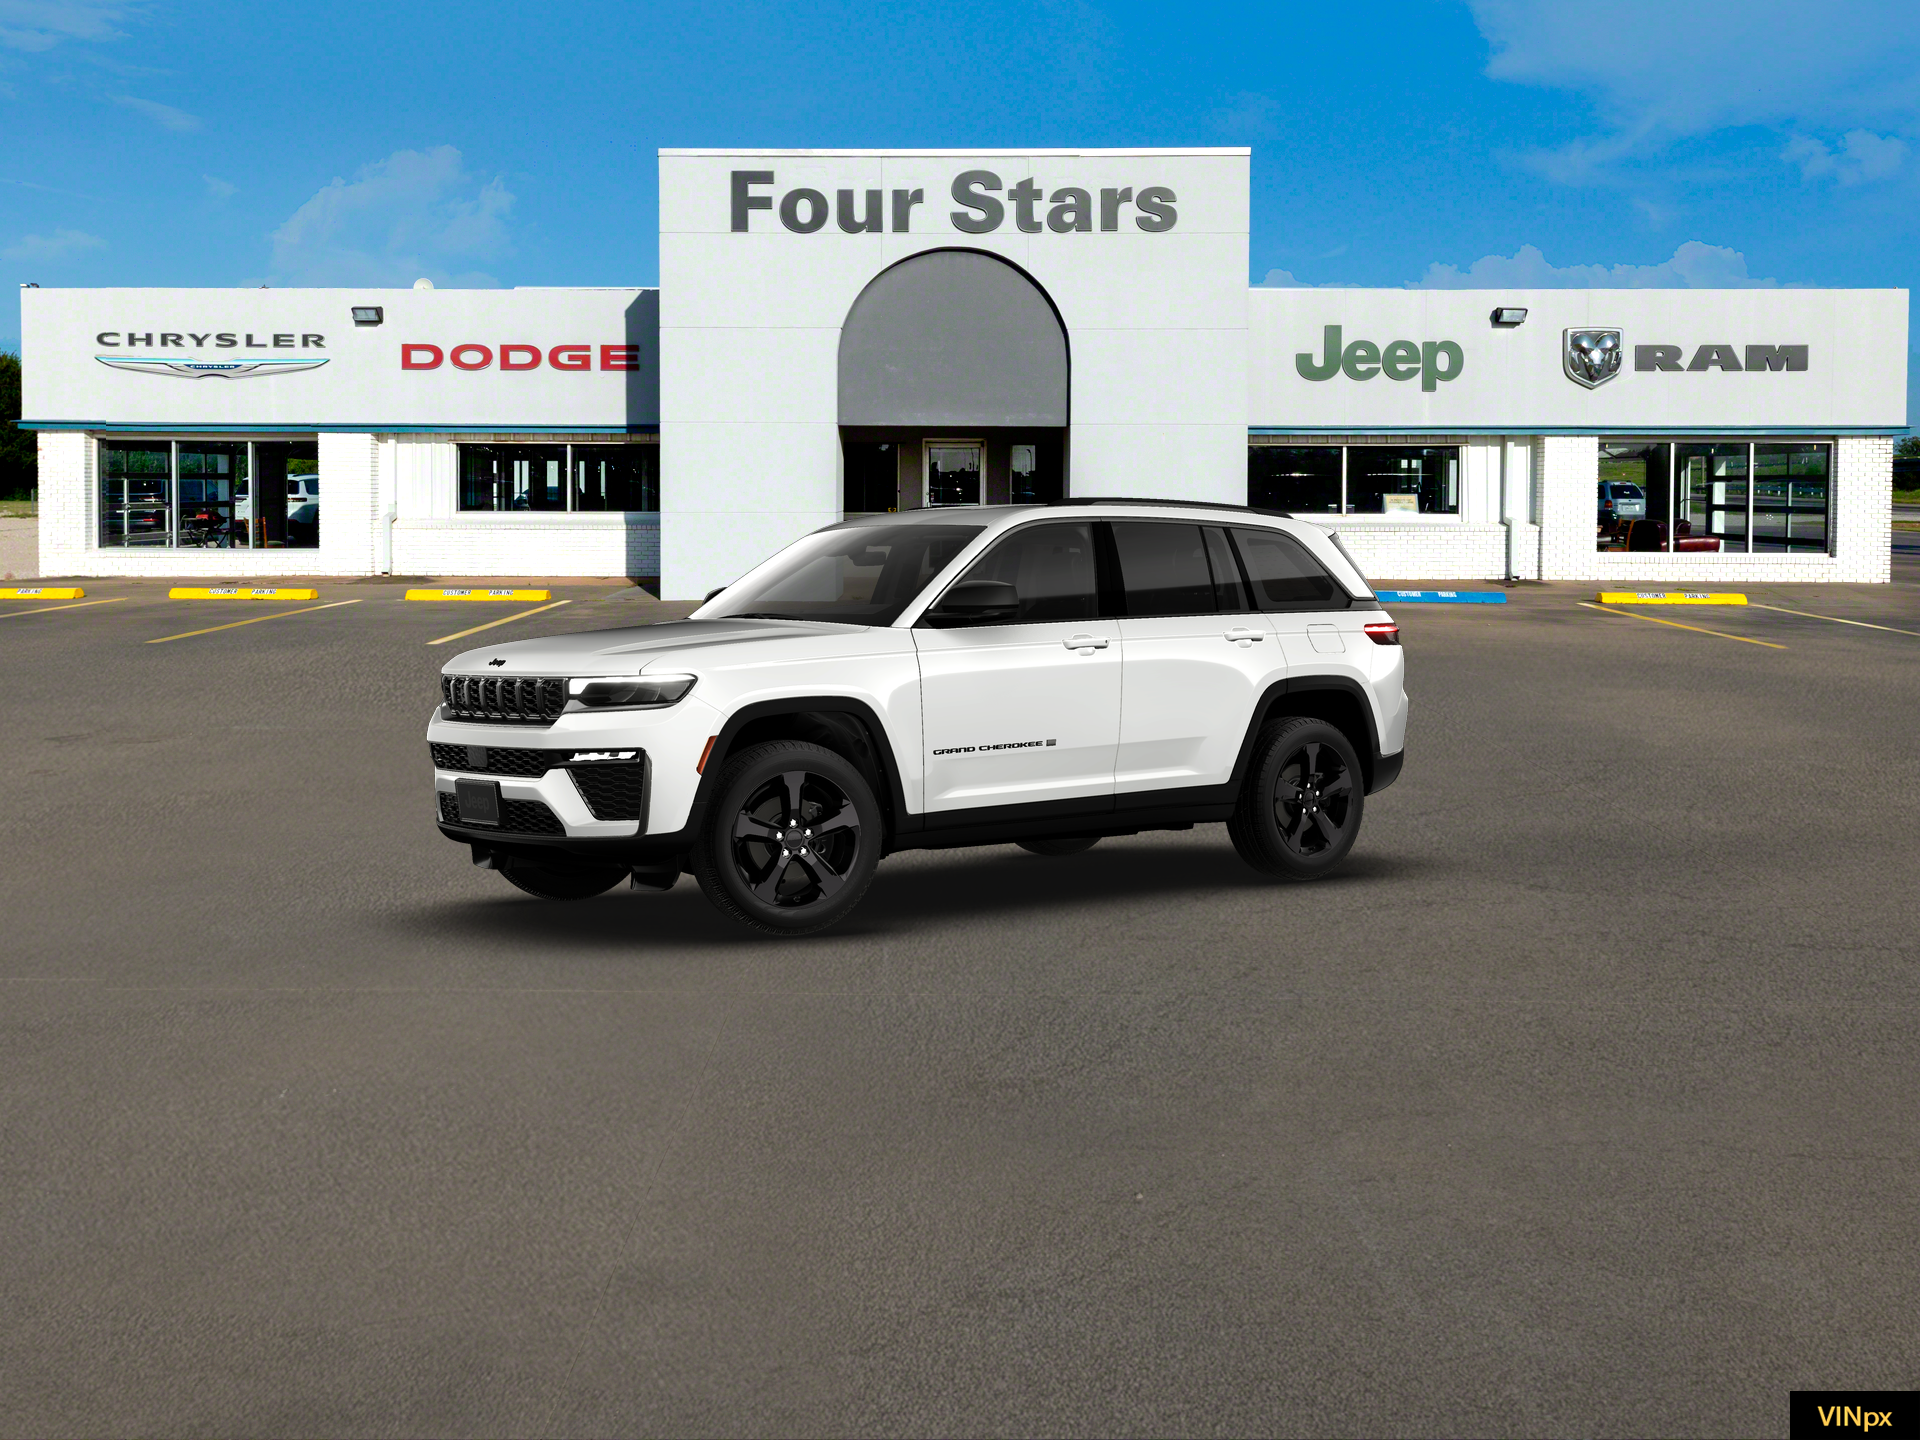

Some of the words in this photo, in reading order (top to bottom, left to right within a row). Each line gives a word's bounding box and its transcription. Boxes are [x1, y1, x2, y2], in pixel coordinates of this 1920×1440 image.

[731, 170, 924, 233] Four
[950, 169, 1178, 234] Stars
[96, 332, 326, 348] CHRYSLER
[401, 343, 640, 371] DODGE
[1295, 325, 1464, 392] Jeep
[1635, 344, 1809, 372] RAM
[933, 746, 976, 756] GRAND
[978, 740, 1044, 752] CHEROKEE
[464, 790, 490, 813] Jeep
